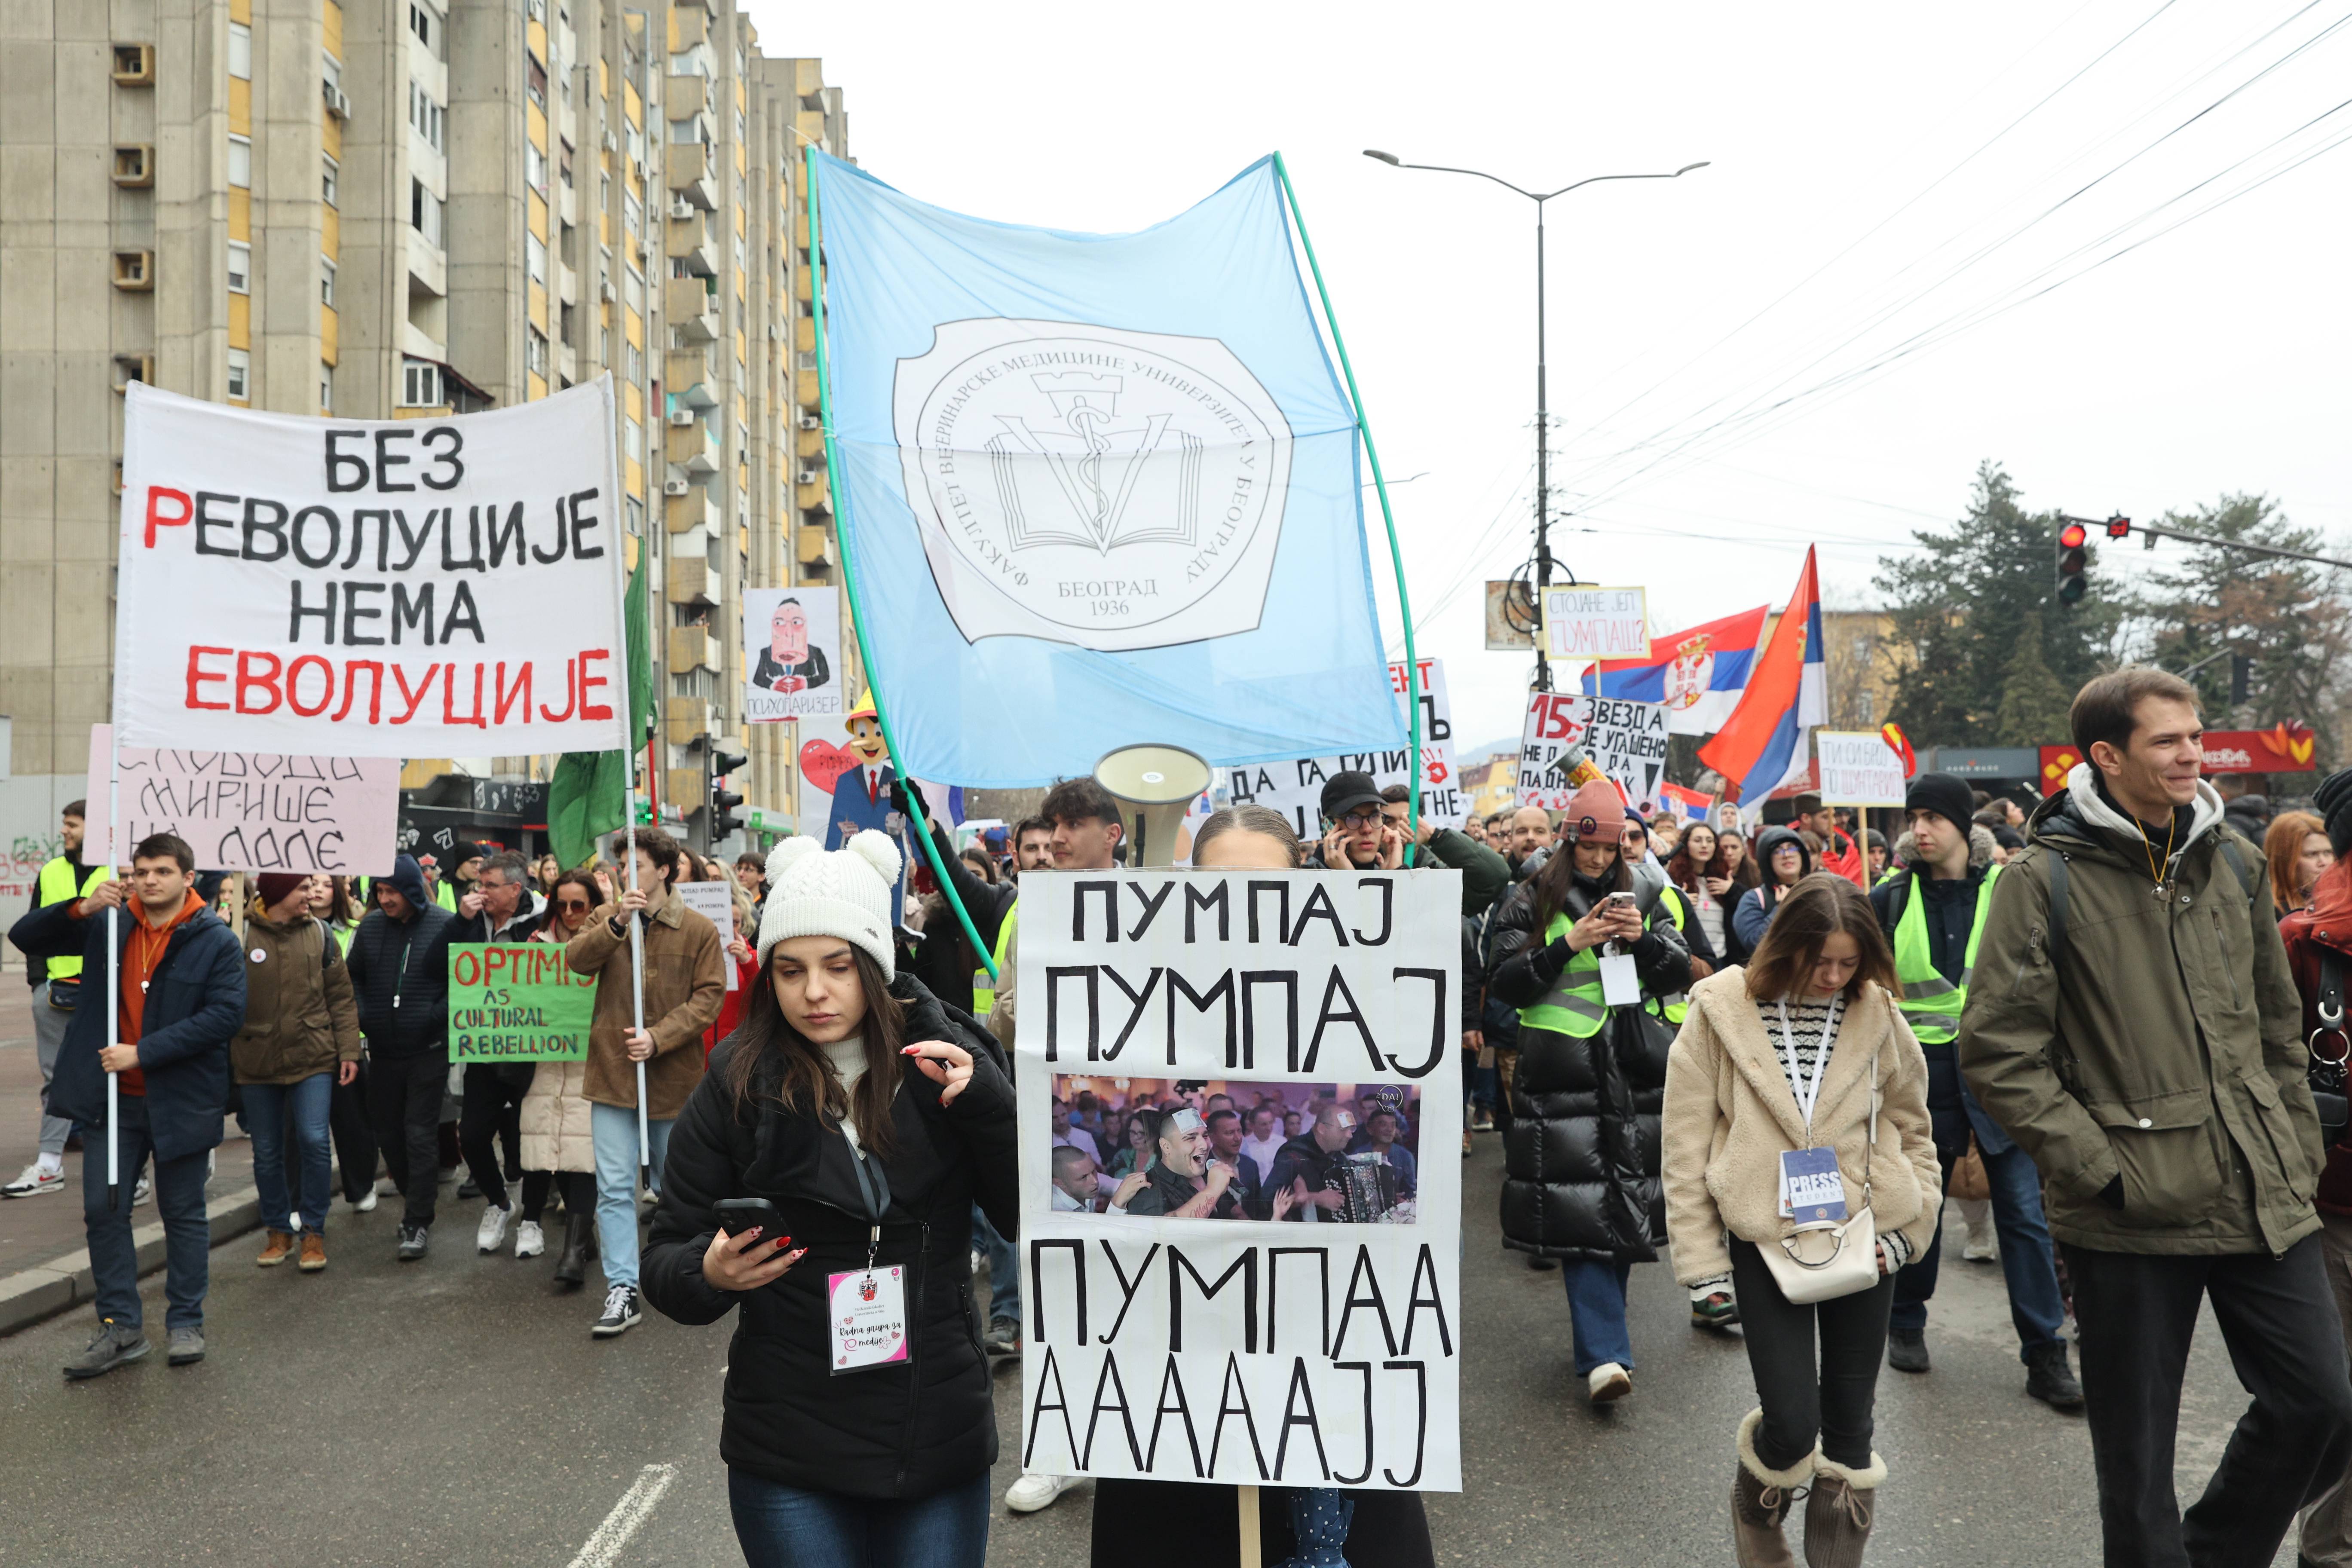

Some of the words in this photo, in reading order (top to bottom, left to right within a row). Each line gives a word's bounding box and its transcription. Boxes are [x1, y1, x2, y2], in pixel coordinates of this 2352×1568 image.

[1002, 352, 1125, 373] МЕДИЦИНЕ
[935, 365, 1002, 475] ВЕЕРИНАРСКЕ
[325, 426, 464, 493] БЕЗ
[1240, 455, 1255, 470] У
[144, 486, 604, 573] РЕВОЛУЦИЈЕ
[946, 481, 1029, 587] ФАКУЛТЕТ
[1186, 476, 1253, 583] БЕОГРАДУ
[1059, 579, 1159, 598] БЕОГРАД
[289, 579, 485, 646] НЕМА
[1090, 600, 1130, 616] 1936
[1550, 619, 1645, 653] ПУМПАШ?
[185, 645, 613, 729] ЕВОЛУЦИЈЕ
[747, 696, 839, 715] ПСИХОПАРИЗЕР
[1530, 694, 1574, 738] 15
[1581, 698, 1663, 734] ЗВЕЗДА
[1523, 744, 1541, 761] НЕ
[1606, 754, 1630, 772] ДА
[1602, 730, 1667, 759] УГАШЕНО
[118, 748, 363, 781] ЛОБОДА
[1231, 768, 1276, 806] ДА
[1296, 758, 1327, 787] ГА
[141, 778, 335, 824] МИРИШЕ
[1072, 878, 1393, 947] ПУМПАЈ
[484, 989, 511, 1005] AS
[453, 1007, 549, 1030] CULTURAL
[1046, 963, 1446, 1078] ПУМПАЈ
[458, 1034, 579, 1057] REBELLION
[1788, 1170, 1841, 1193] PRESS
[1792, 1190, 1843, 1202] STUDENT
[1030, 1238, 1454, 1361] ПУМПАА
[839, 1327, 864, 1336] Radna
[867, 1324, 890, 1334] grupa
[859, 1337, 884, 1346] medije
[1023, 1344, 1427, 1487] АААААЈЈ
